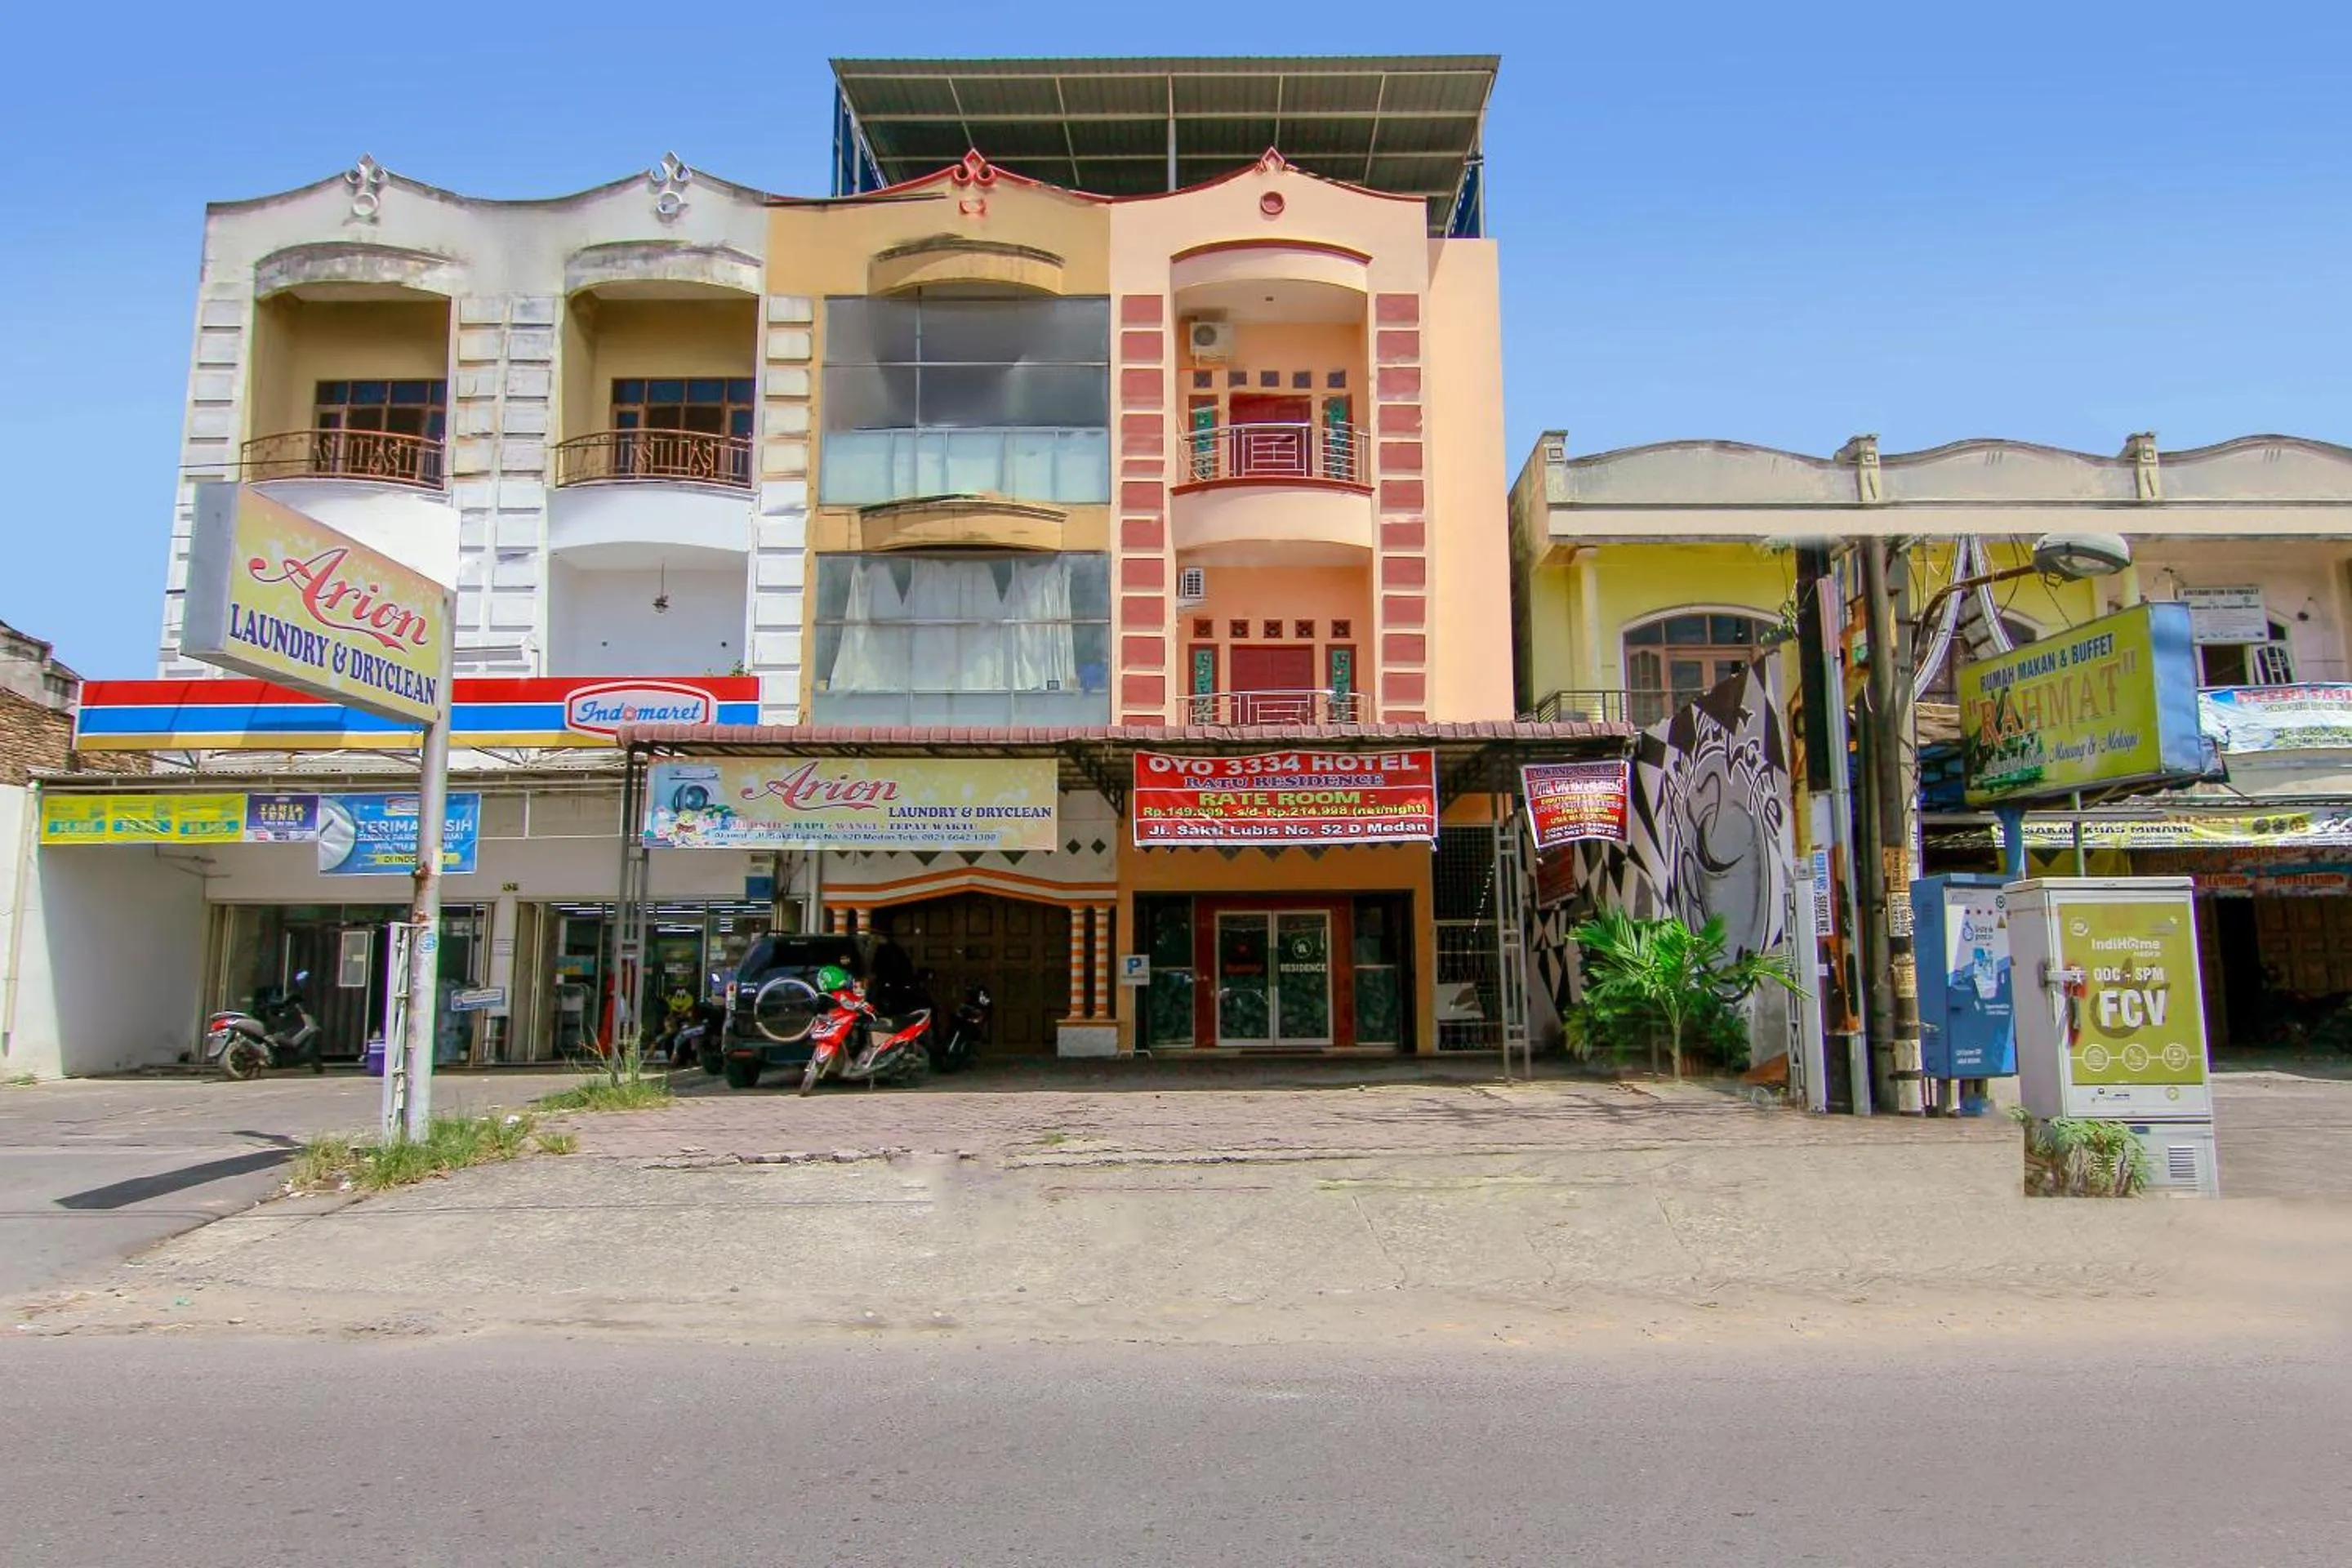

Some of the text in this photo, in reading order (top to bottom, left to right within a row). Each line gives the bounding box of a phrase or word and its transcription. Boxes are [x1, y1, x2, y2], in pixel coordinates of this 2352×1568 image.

[247, 547, 430, 653] Arion
[229, 603, 437, 706] LAUNDRY & DRYCLEAN
[1980, 633, 2114, 693] RUMAH MAKAN & BUFFET
[577, 701, 701, 723] Indomaret
[1149, 753, 1419, 775] OYO 3334 HOTEL
[741, 760, 901, 811] Arion
[1184, 774, 1385, 790] RATU RESIDENCE
[1199, 792, 1268, 806] RATE
[1277, 791, 1361, 805] ROOM
[889, 806, 1053, 817] LAUNDRY & DRYCLEAN
[1352, 804, 1427, 816] (net/night)
[357, 819, 474, 833] TERIMA SIH
[1177, 825, 1223, 836] Sakti
[1230, 825, 1279, 835] Lubis
[1321, 824, 1343, 835] 52
[1349, 824, 1361, 834] D
[1367, 822, 1428, 833] Medan
[2091, 937, 2160, 951] IndiHome
[1127, 957, 1142, 974] P
[2094, 967, 2121, 982] ODC
[2135, 967, 2165, 982] SPM
[2099, 988, 2167, 1027] FCV
